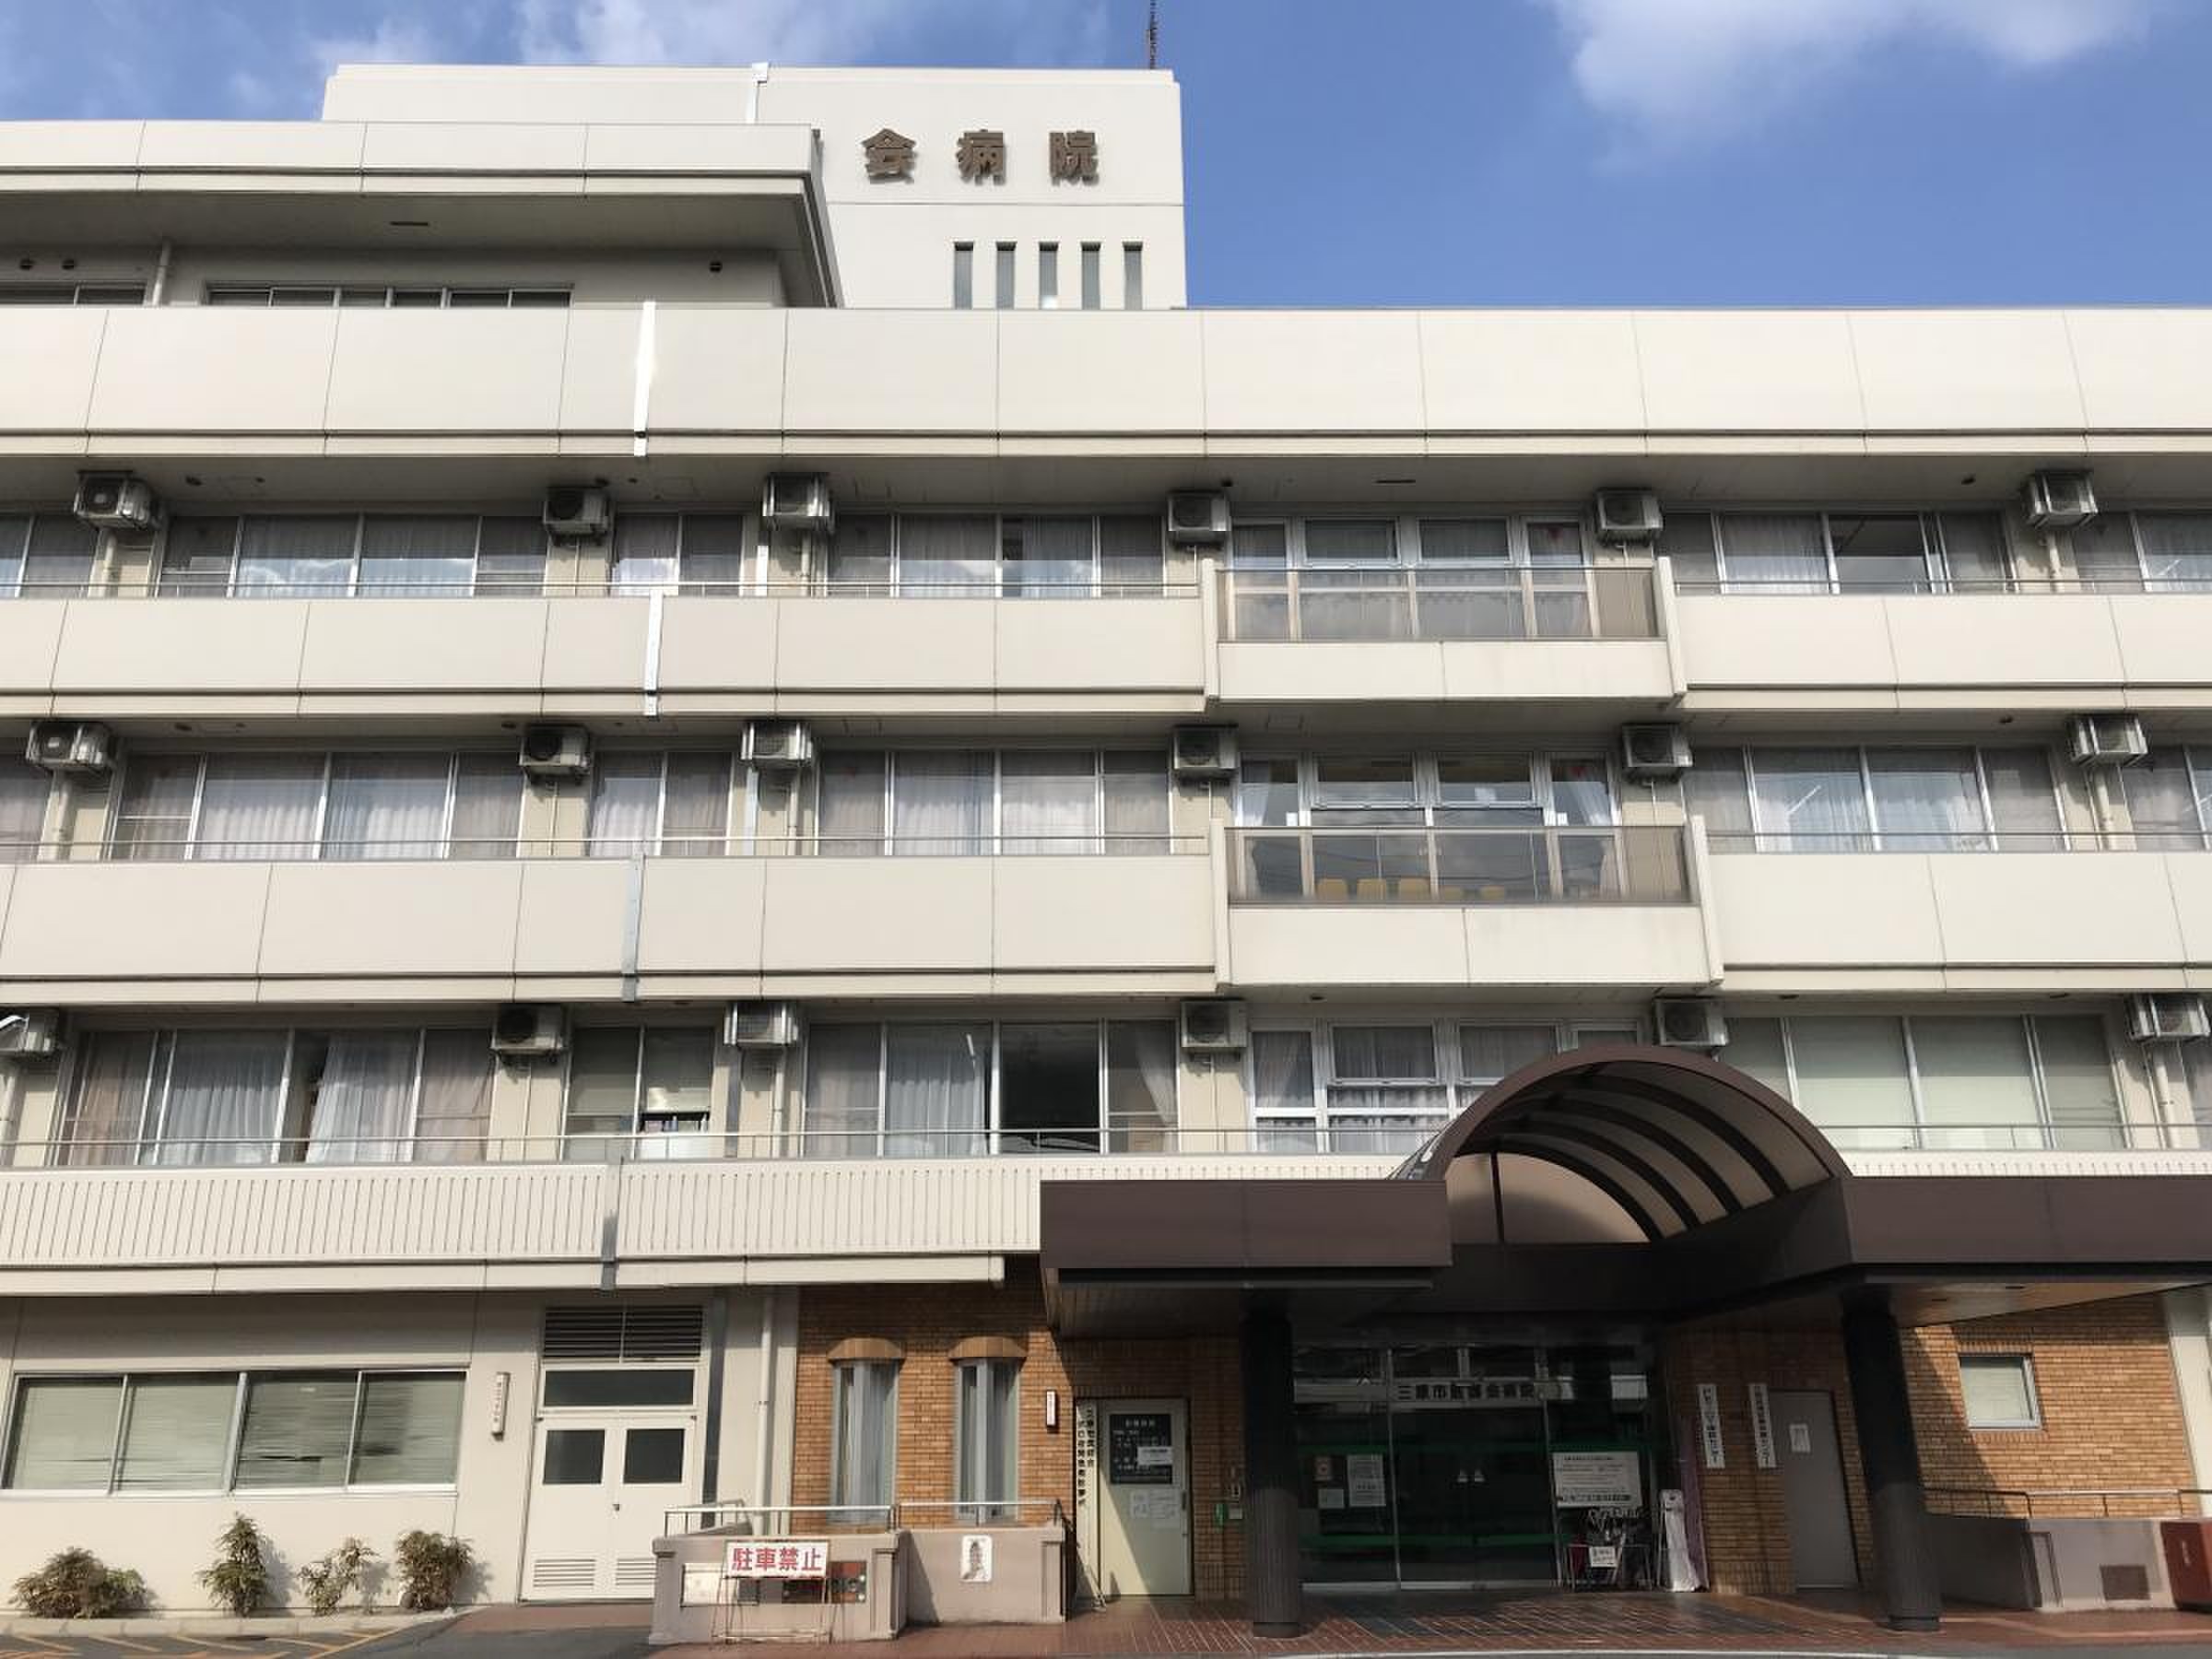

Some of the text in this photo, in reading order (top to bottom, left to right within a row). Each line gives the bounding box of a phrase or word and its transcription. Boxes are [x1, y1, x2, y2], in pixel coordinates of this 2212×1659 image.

[863, 128, 1098, 184] 会病院
[731, 1546, 824, 1571] 駐車禁止
